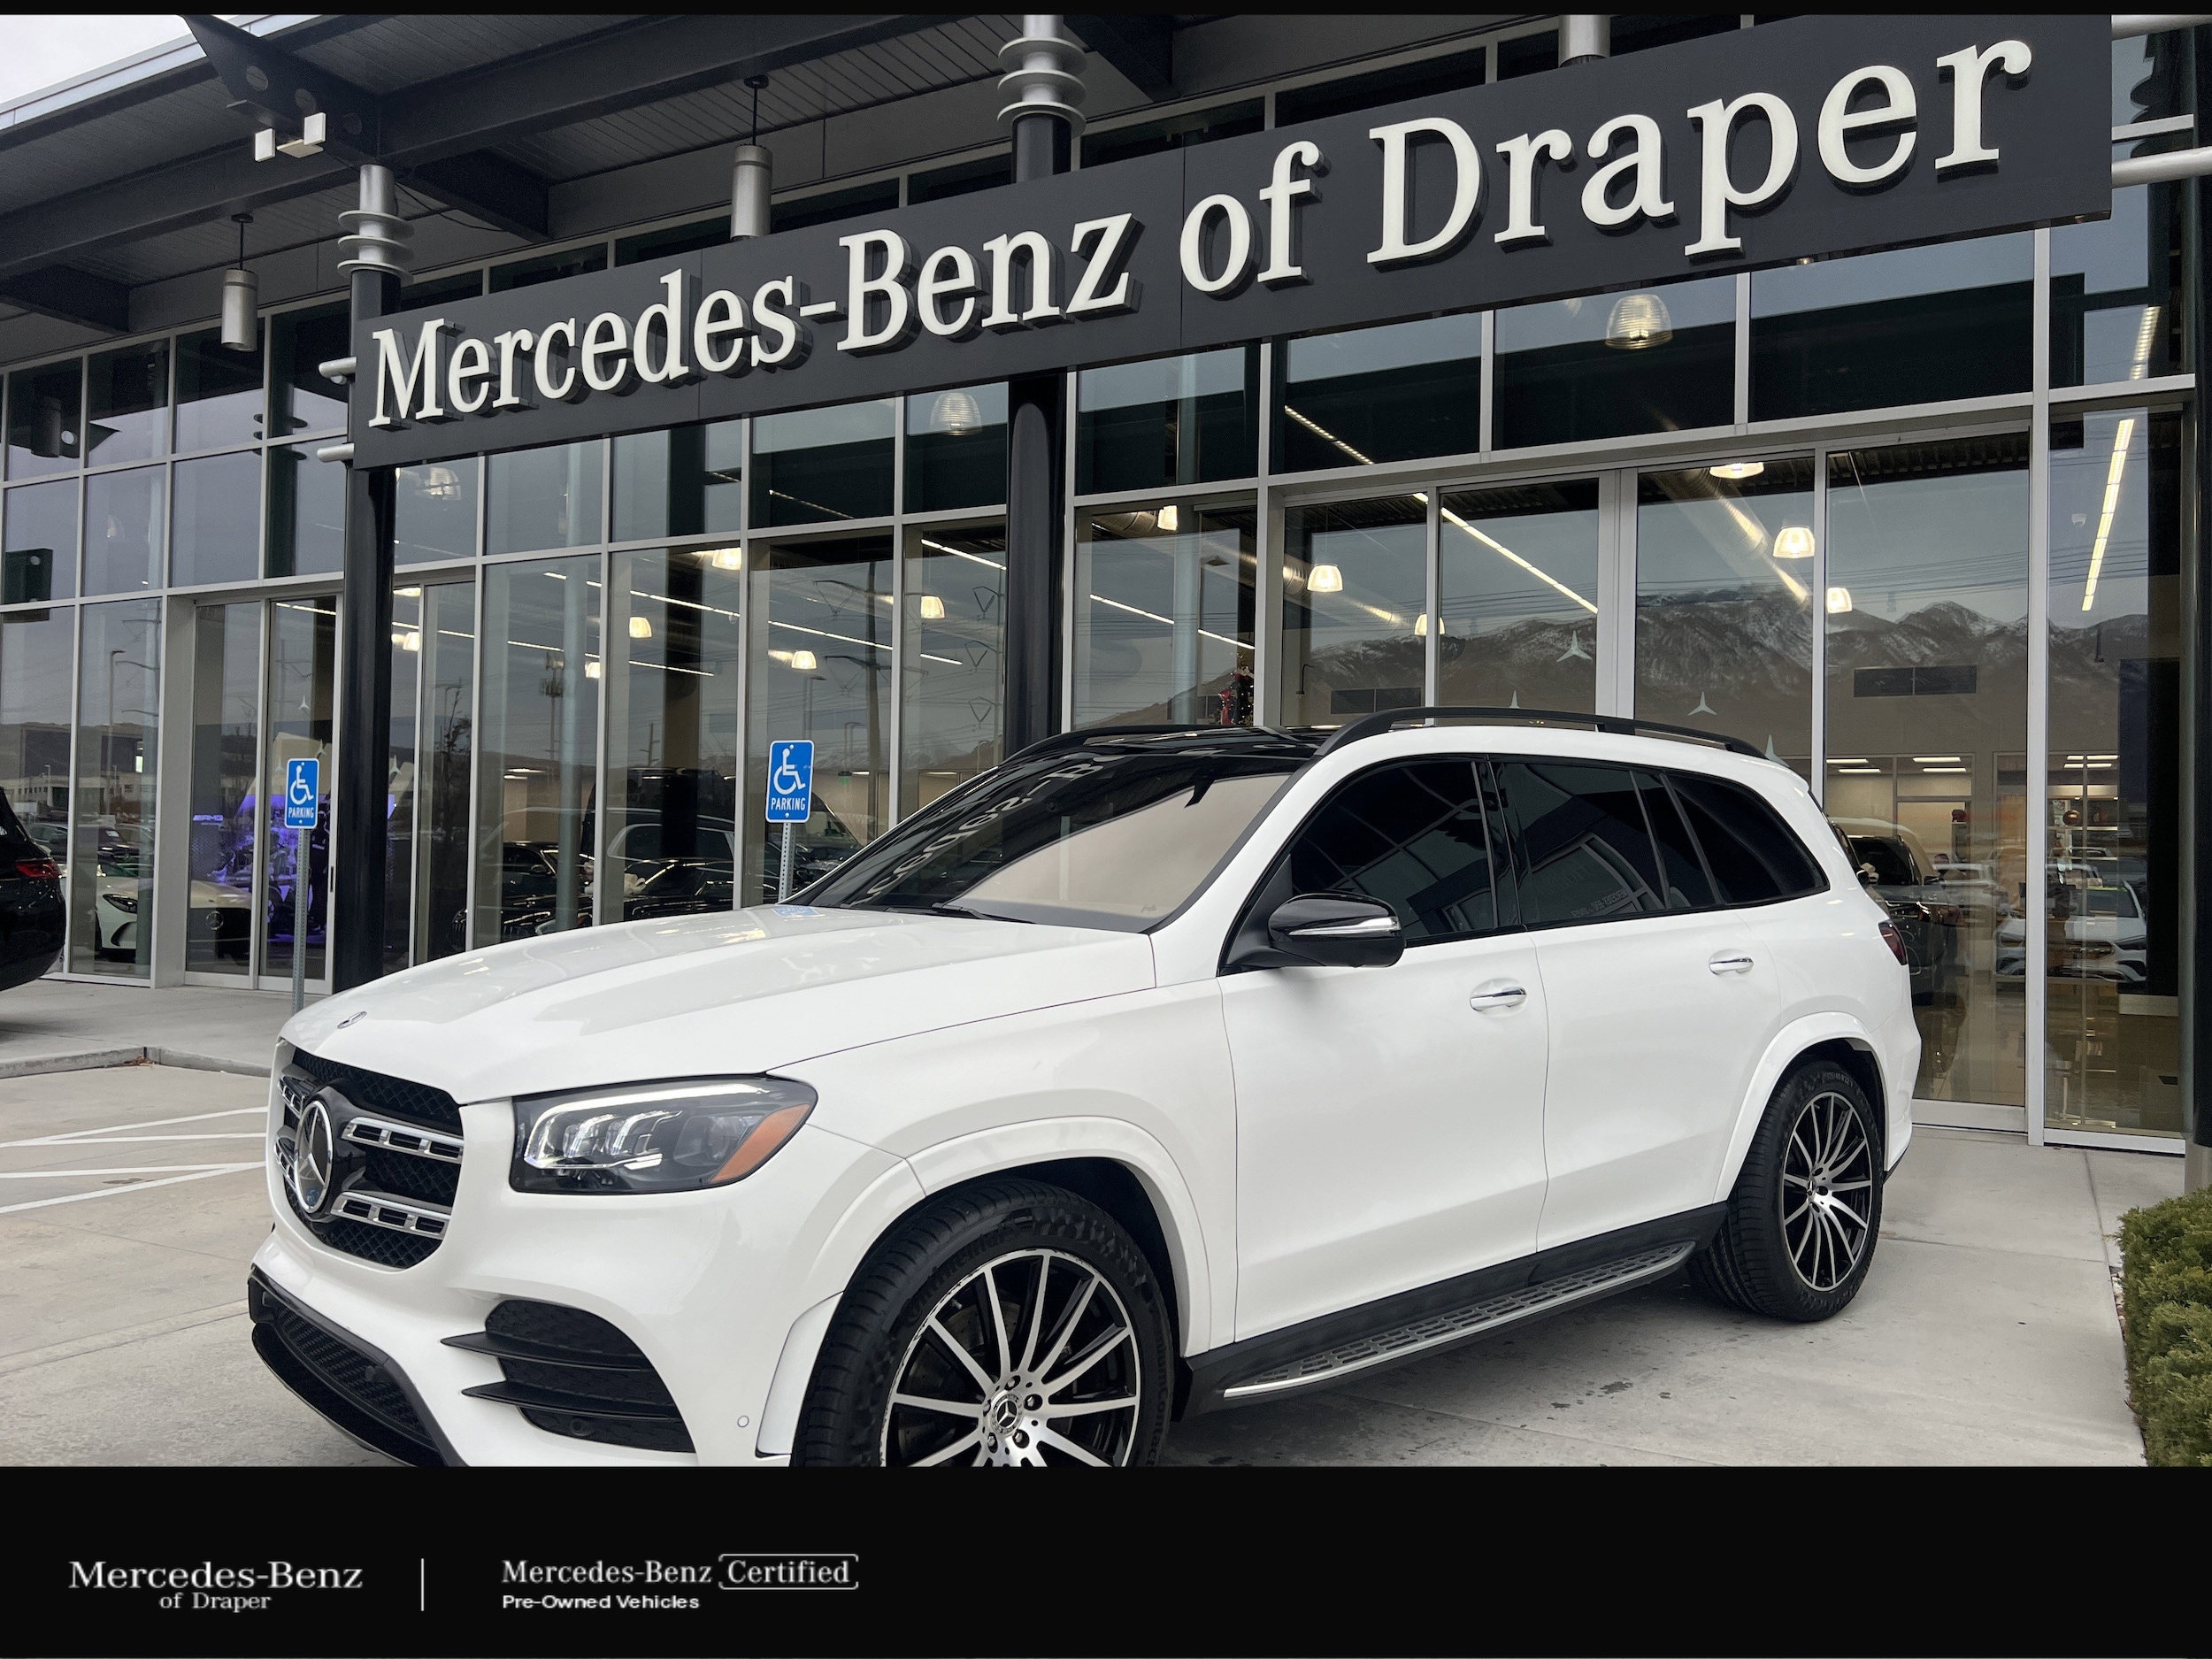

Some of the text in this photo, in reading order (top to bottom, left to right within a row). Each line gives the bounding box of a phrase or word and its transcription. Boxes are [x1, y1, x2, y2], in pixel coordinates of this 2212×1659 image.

[368, 39, 2032, 428] Mercedes-Benz of Draper
[771, 797, 806, 810] PARKING
[288, 806, 314, 818] PARKING
